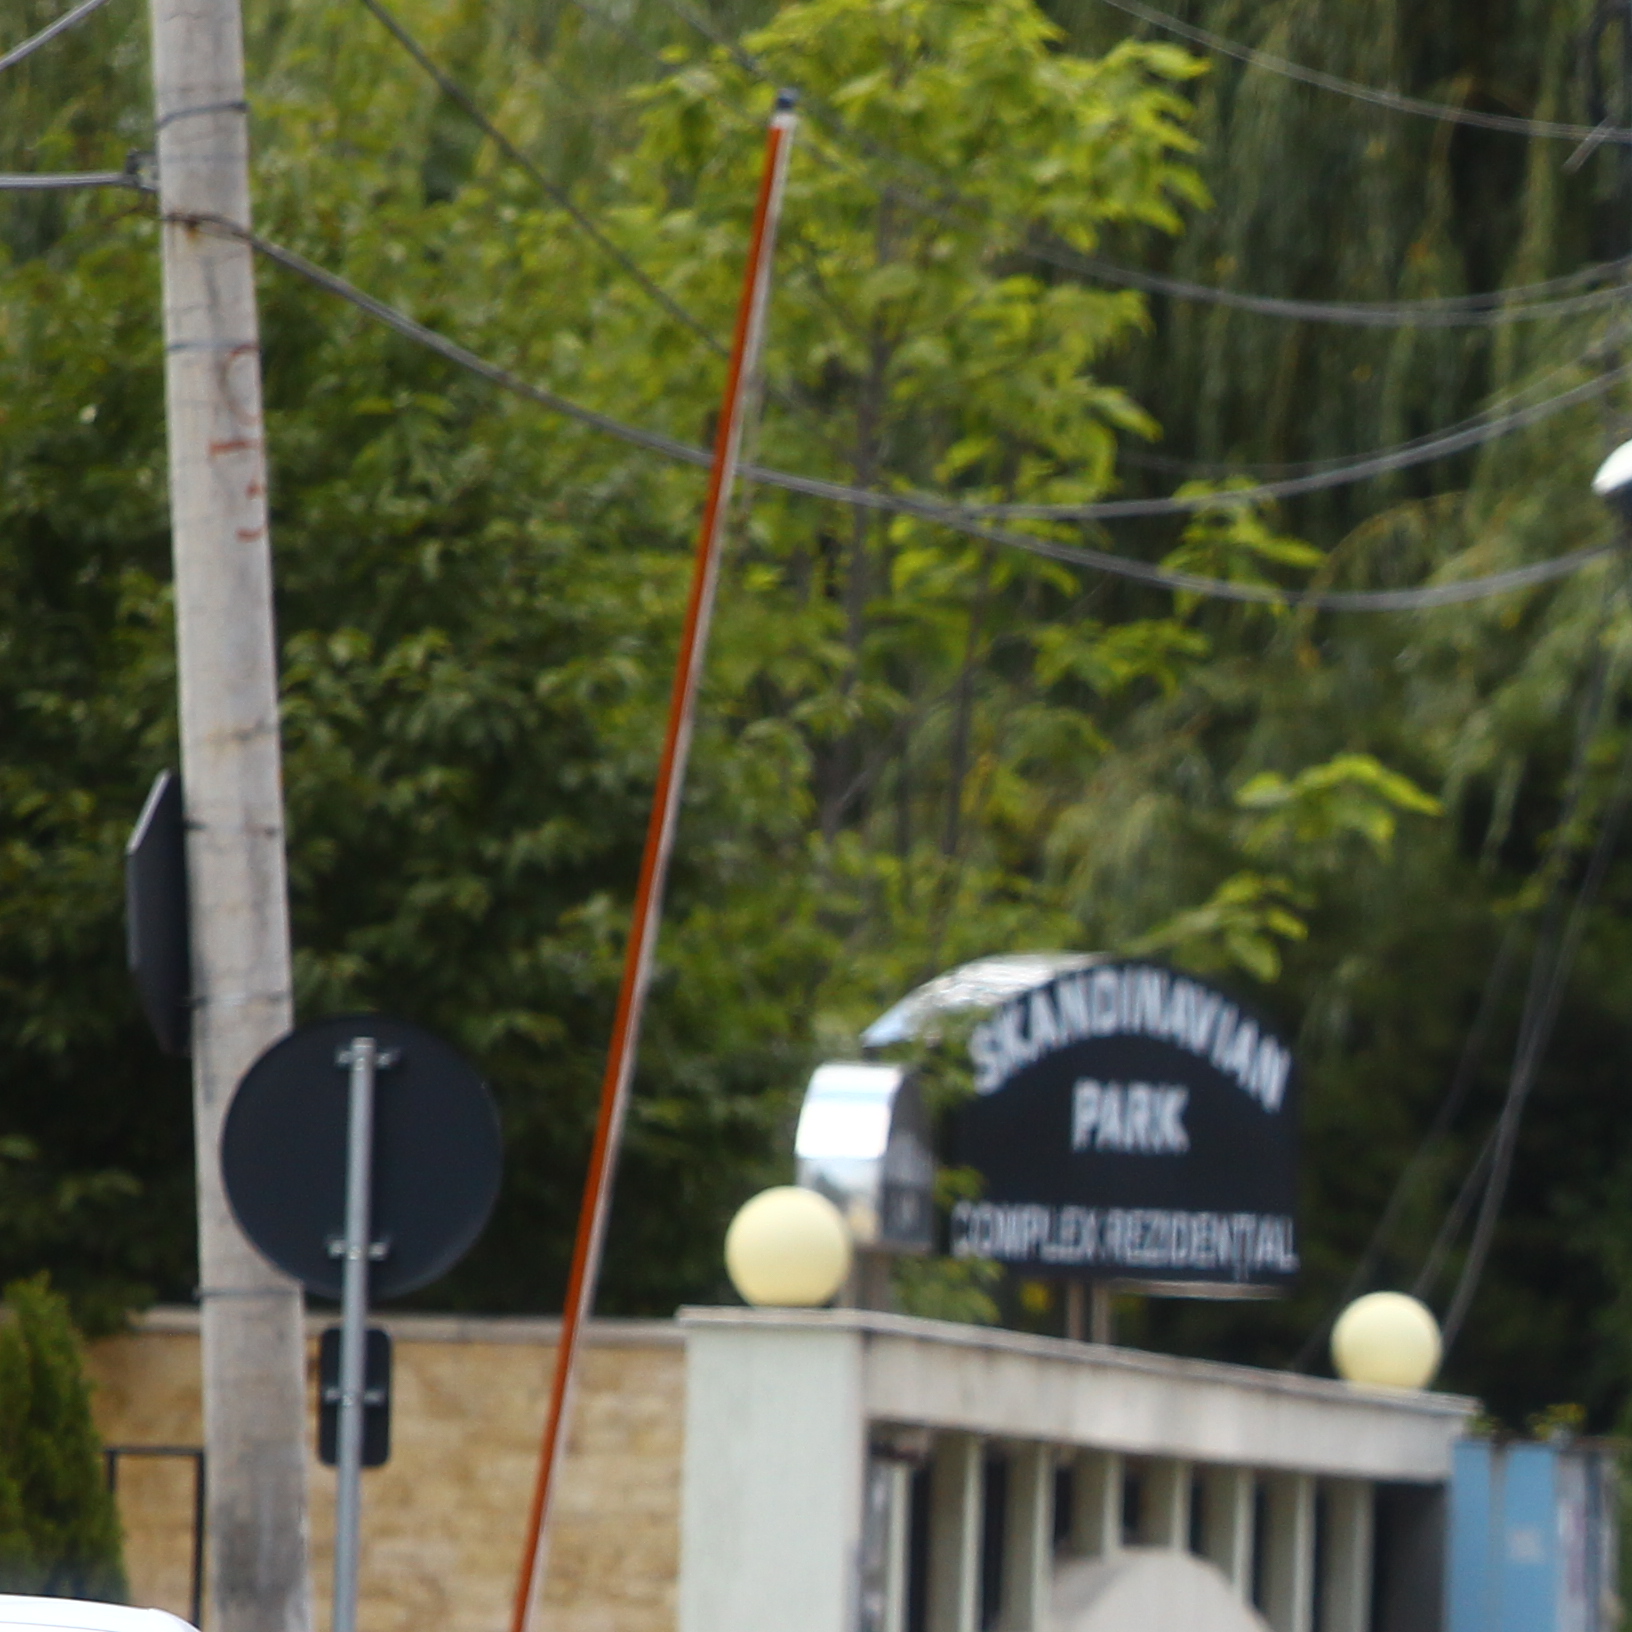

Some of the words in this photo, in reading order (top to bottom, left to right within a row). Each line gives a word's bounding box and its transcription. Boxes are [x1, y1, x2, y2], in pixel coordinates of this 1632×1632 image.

[970, 965, 1291, 1111] SKANDINAVIAN
[1072, 1078, 1189, 1152] PARK
[952, 1201, 1098, 1264] COMPLEX
